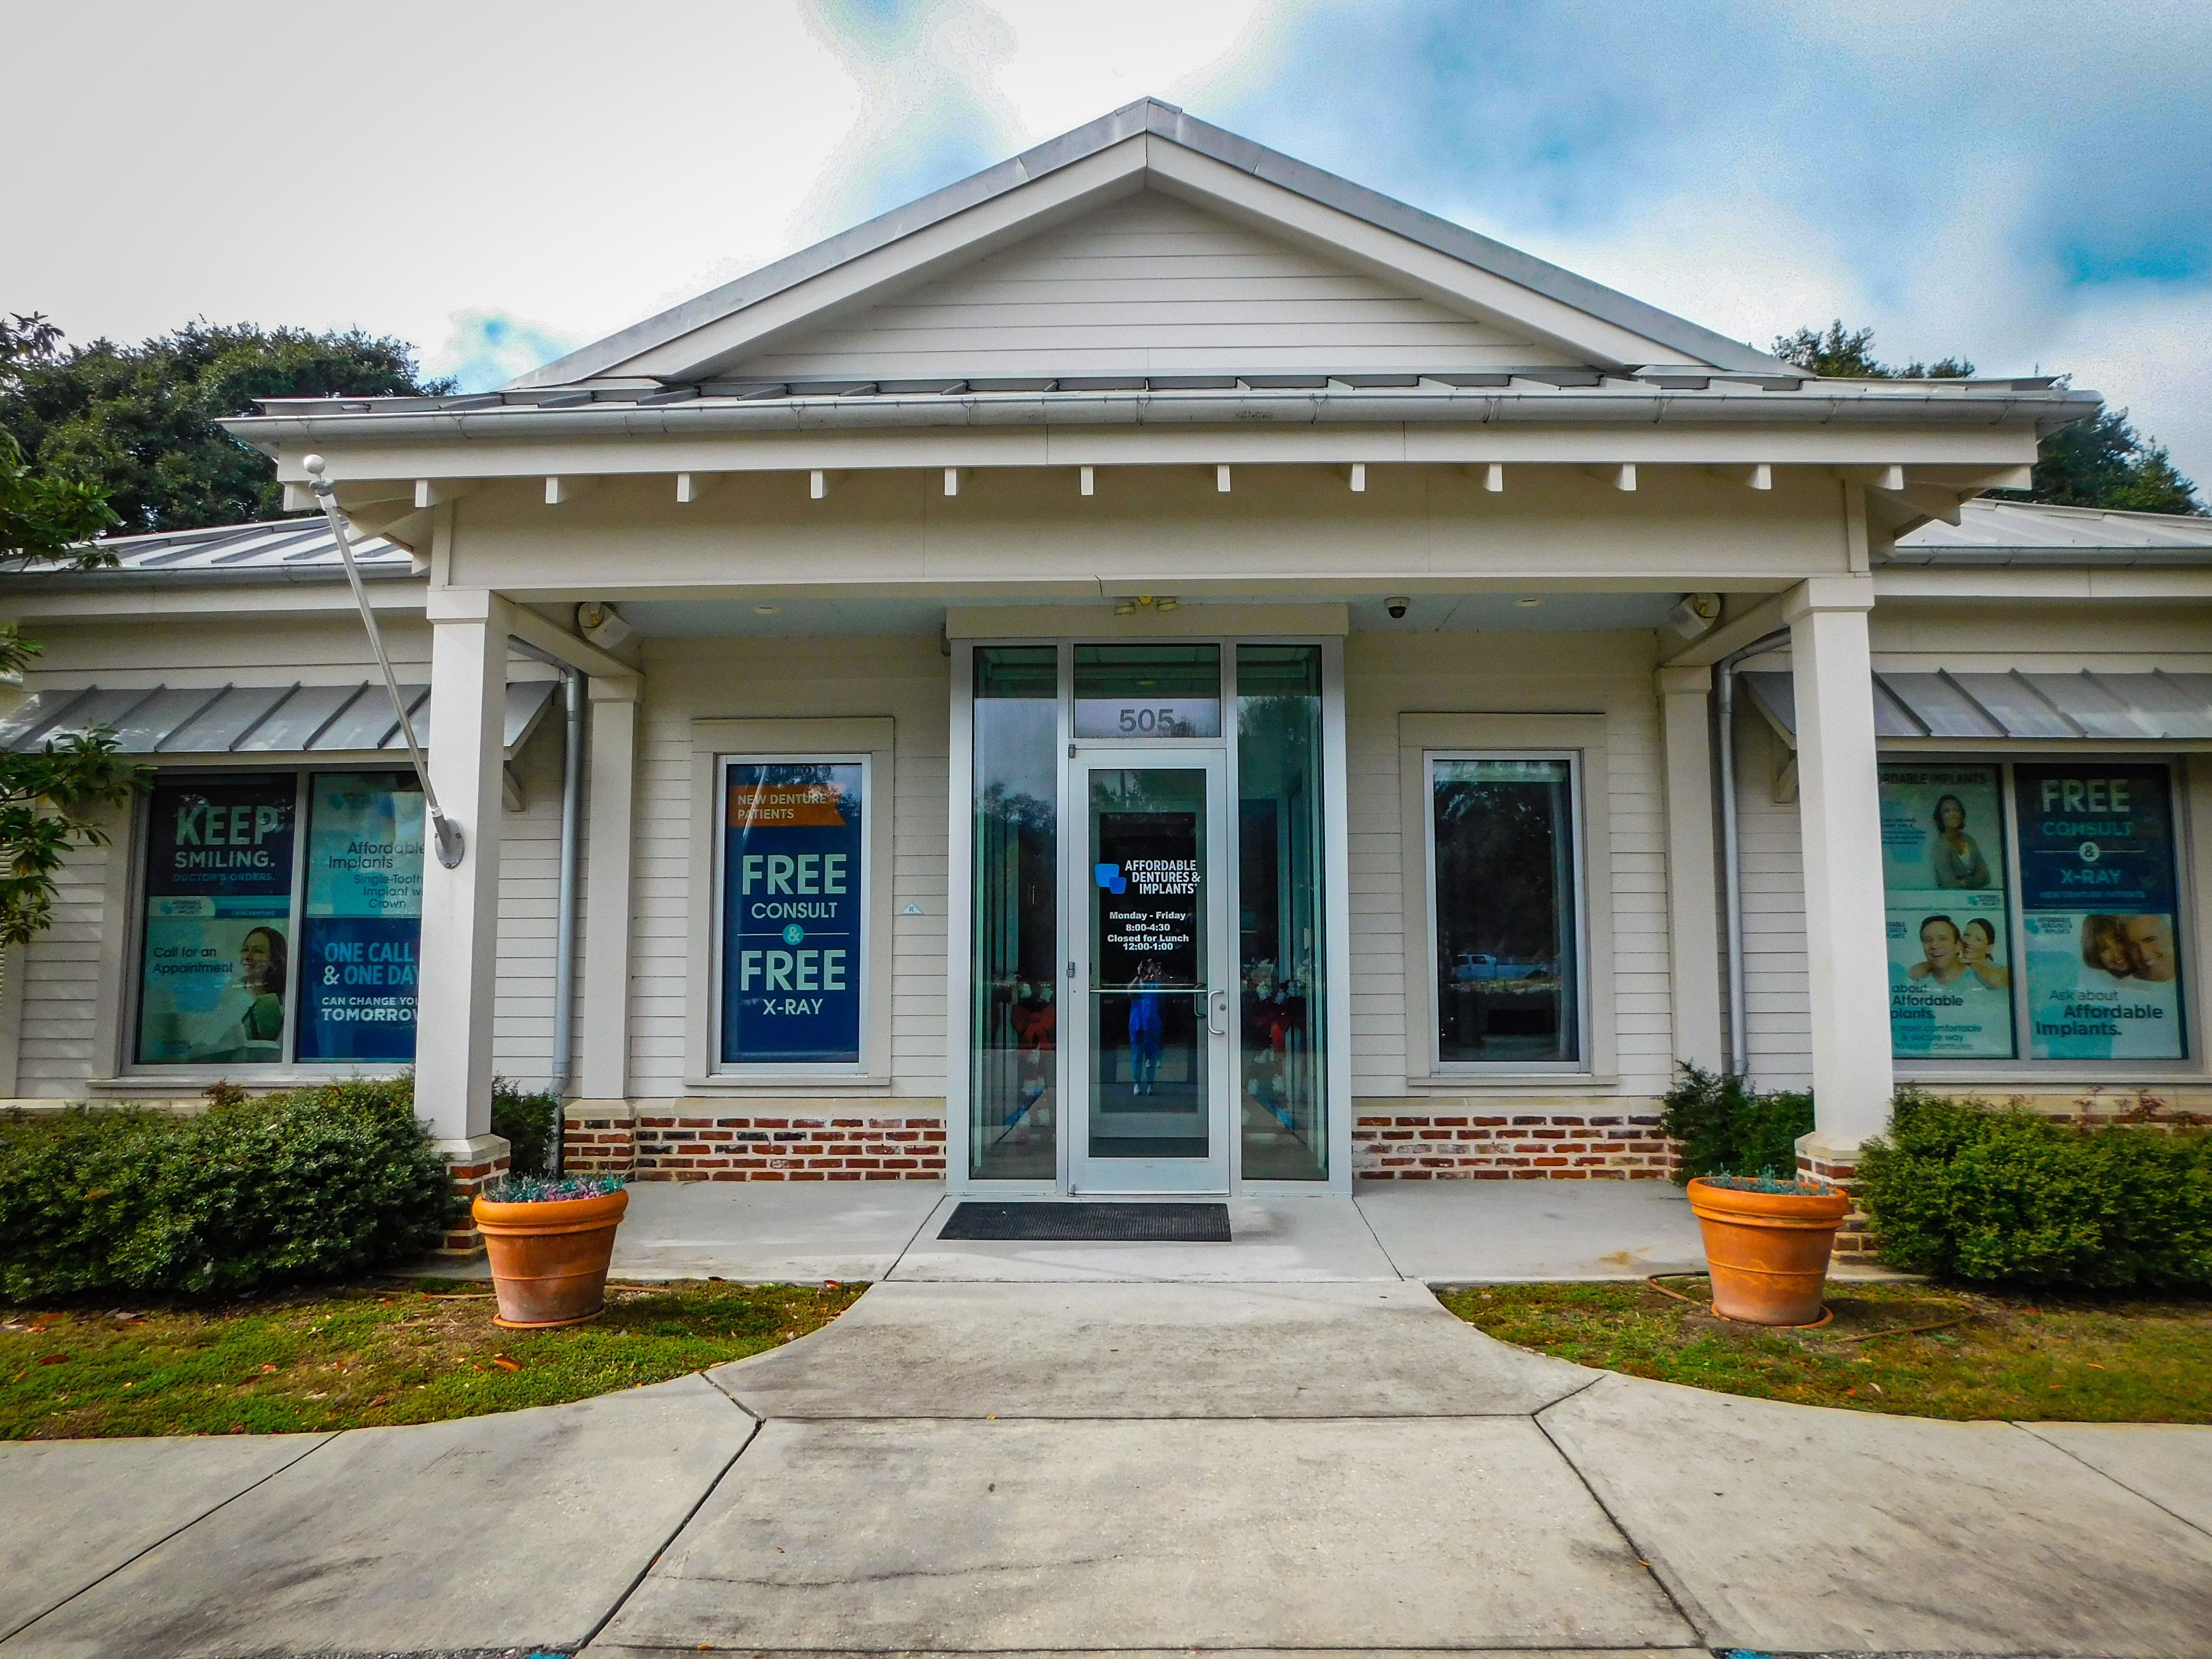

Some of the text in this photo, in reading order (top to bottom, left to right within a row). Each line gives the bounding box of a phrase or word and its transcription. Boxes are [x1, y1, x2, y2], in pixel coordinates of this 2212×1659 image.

[1119, 708, 1176, 732] 505
[1880, 773, 1927, 784] RDABLE
[738, 794, 827, 805] NEW DENTURE
[2042, 779, 2130, 812] FREE
[738, 809, 794, 819] PATIENTS
[176, 805, 279, 846] KEEP
[2042, 821, 2134, 836] CONSULT
[2085, 845, 2093, 857] &
[174, 850, 275, 868] SMILING.
[328, 856, 393, 871] Implants
[1125, 860, 1196, 871] AFFORDABLE
[742, 854, 847, 895] FREE
[1132, 872, 1201, 882] DENTURES &
[2061, 869, 2121, 884] X-RAY
[363, 886, 408, 897] Implant
[369, 899, 406, 908] Crown
[751, 903, 838, 918] CONSULT
[1109, 911, 1147, 921] Monday
[1156, 911, 1186, 921] Friday
[1126, 923, 1171, 931] 8:00-4:30
[786, 926, 800, 942] &
[153, 946, 217, 957] Call for an
[325, 942, 414, 963] ONE CALL
[153, 963, 234, 976] Appointment
[323, 965, 340, 985] &
[344, 965, 383, 985] ONE
[741, 950, 846, 991] FREE
[322, 997, 346, 1006] CAN
[349, 997, 396, 1006] CHANGE
[1893, 995, 1964, 1006] Affordable
[2050, 990, 2120, 1001] Ask about
[763, 998, 823, 1015] X-RAY
[2063, 1005, 2163, 1018] Affordable
[2036, 1021, 2122, 1037] Implants.
